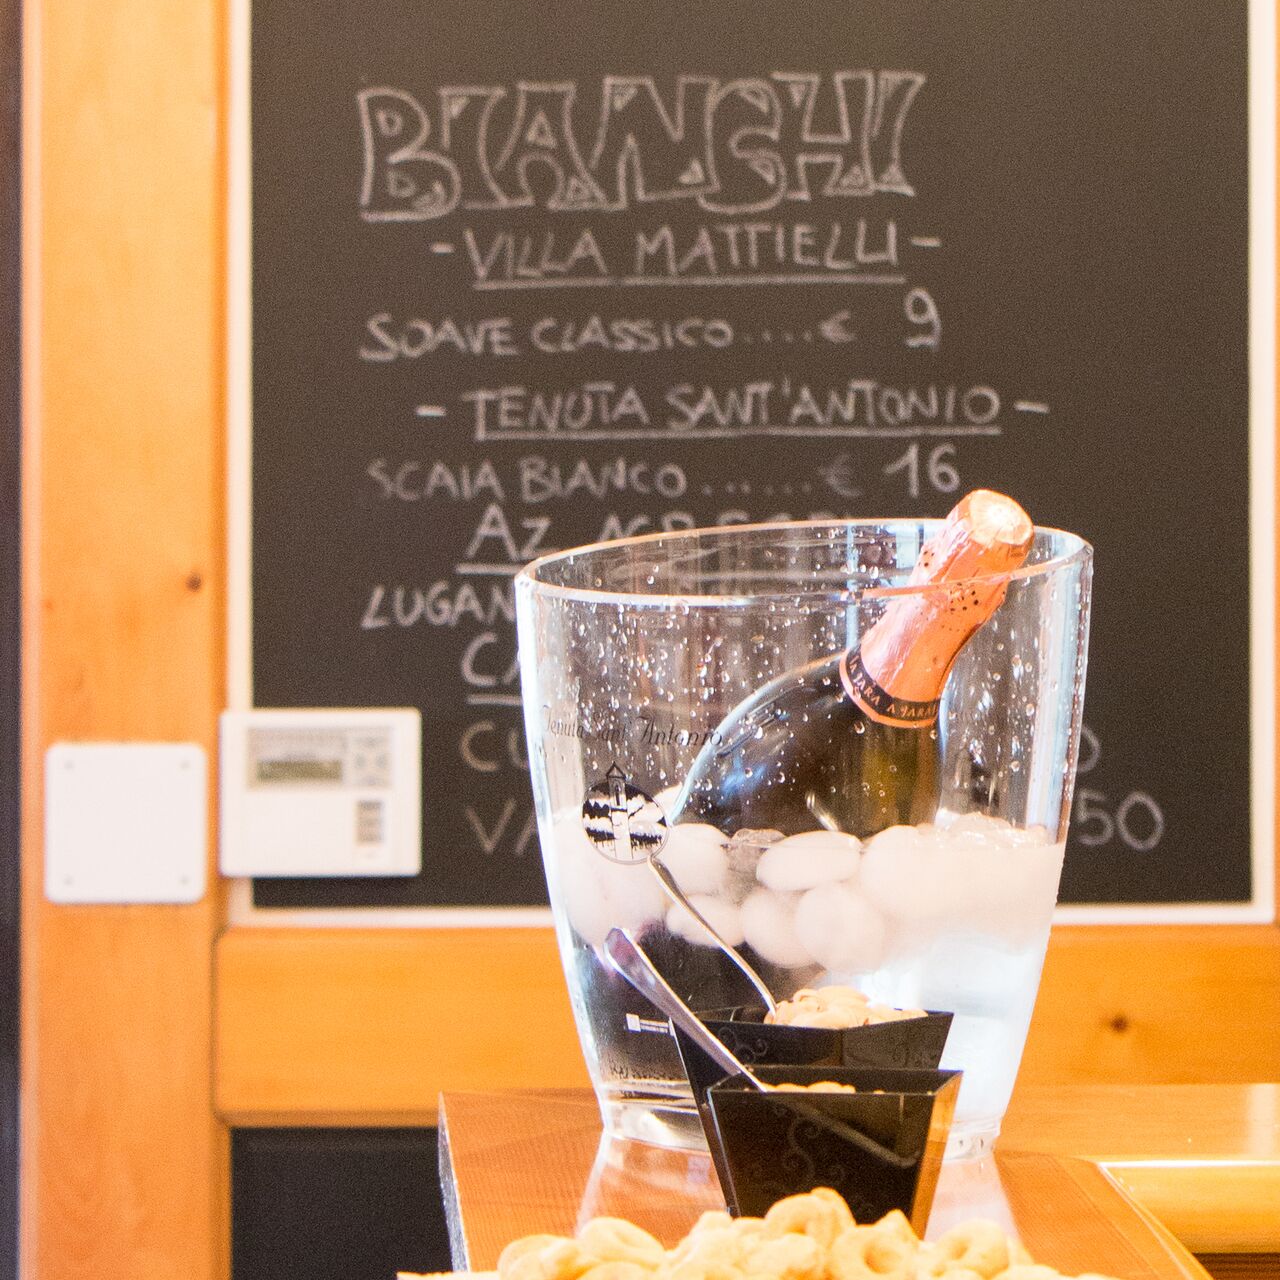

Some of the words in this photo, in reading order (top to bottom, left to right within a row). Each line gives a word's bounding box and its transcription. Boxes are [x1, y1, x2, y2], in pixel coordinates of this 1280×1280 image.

[356, 69, 928, 221] BIANCHI
[462, 227, 609, 280] VILLA
[636, 217, 899, 273] MATTIELLI
[358, 310, 520, 363] SOAVE
[529, 314, 735, 354] CLASSICO
[904, 286, 943, 350] 9
[461, 378, 652, 442] TENUTA
[366, 456, 506, 504] SCAIA
[518, 453, 690, 504] BIANCO
[882, 442, 961, 500] 16
